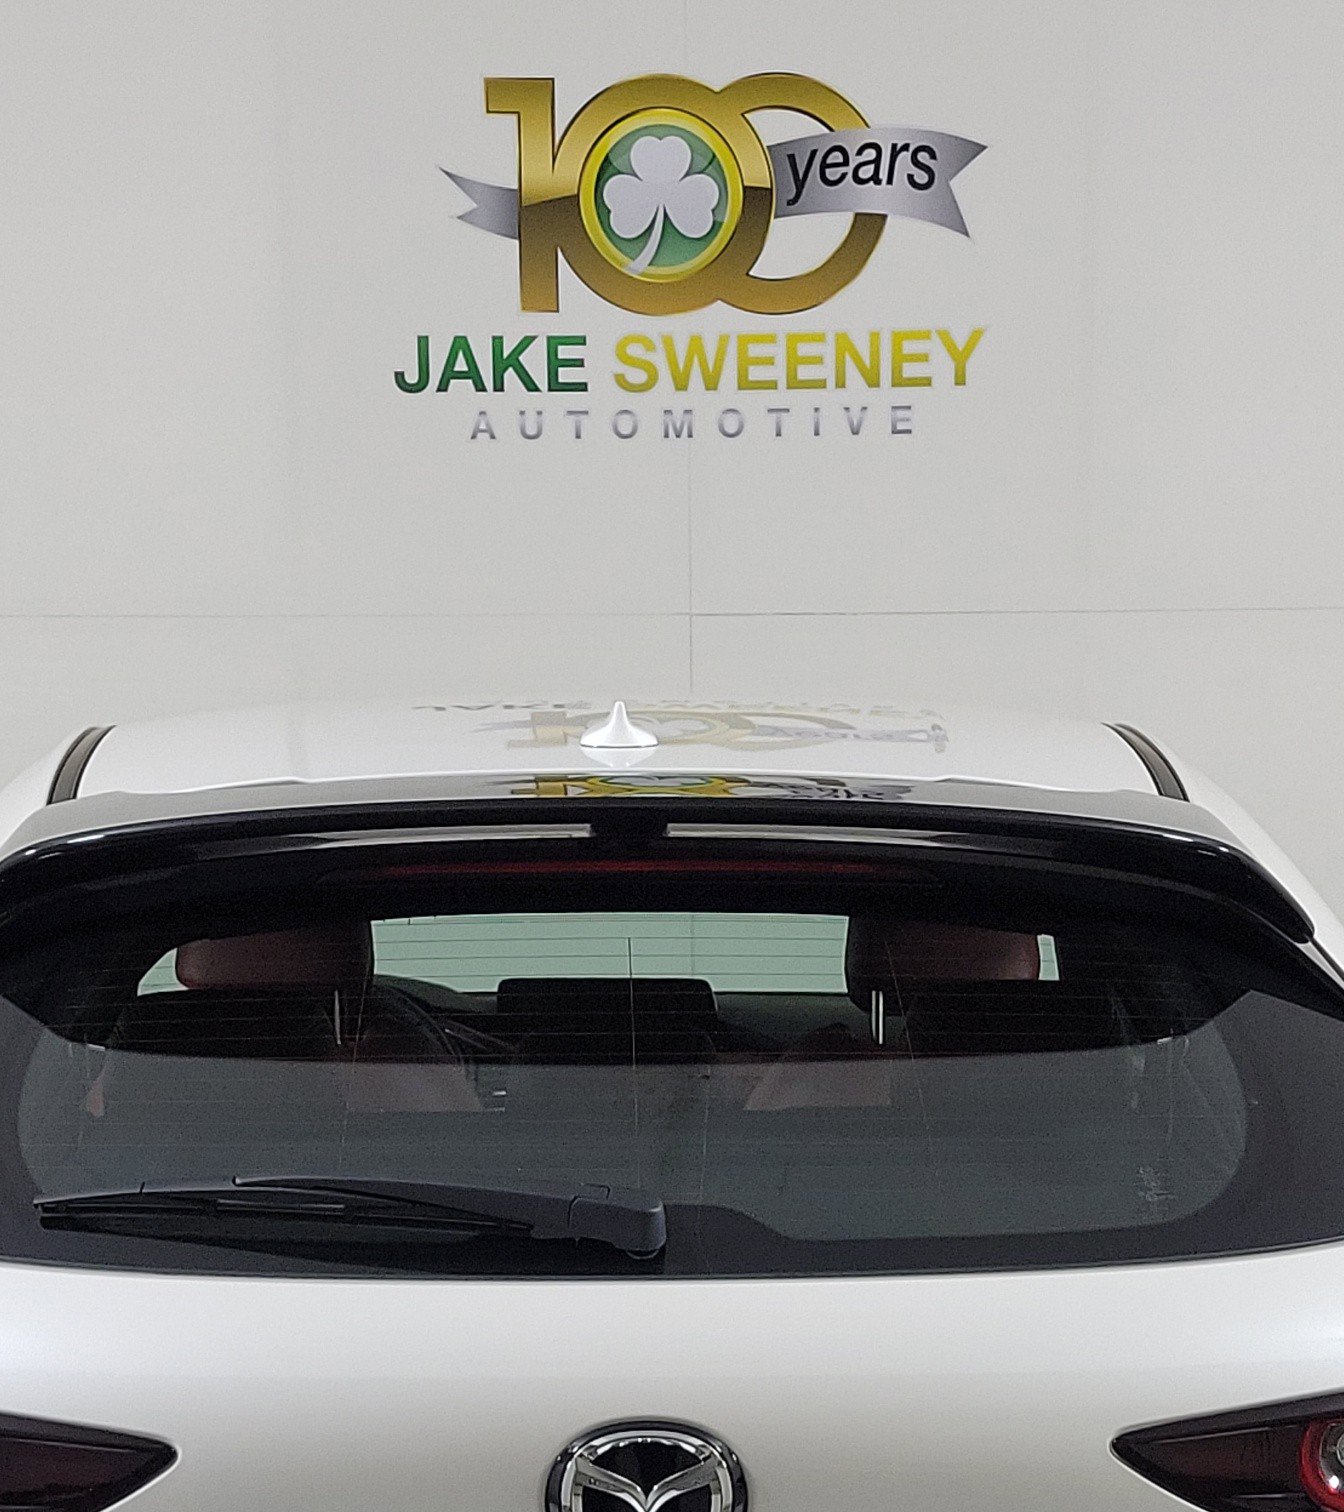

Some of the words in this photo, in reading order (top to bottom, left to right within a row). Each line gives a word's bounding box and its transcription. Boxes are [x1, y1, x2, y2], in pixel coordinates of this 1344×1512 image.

[483, 72, 887, 316] 100
[786, 140, 937, 206] years
[393, 334, 588, 394] JAKE
[613, 328, 986, 392] SWEENEY
[470, 404, 913, 440] AUTOMOTIVE
